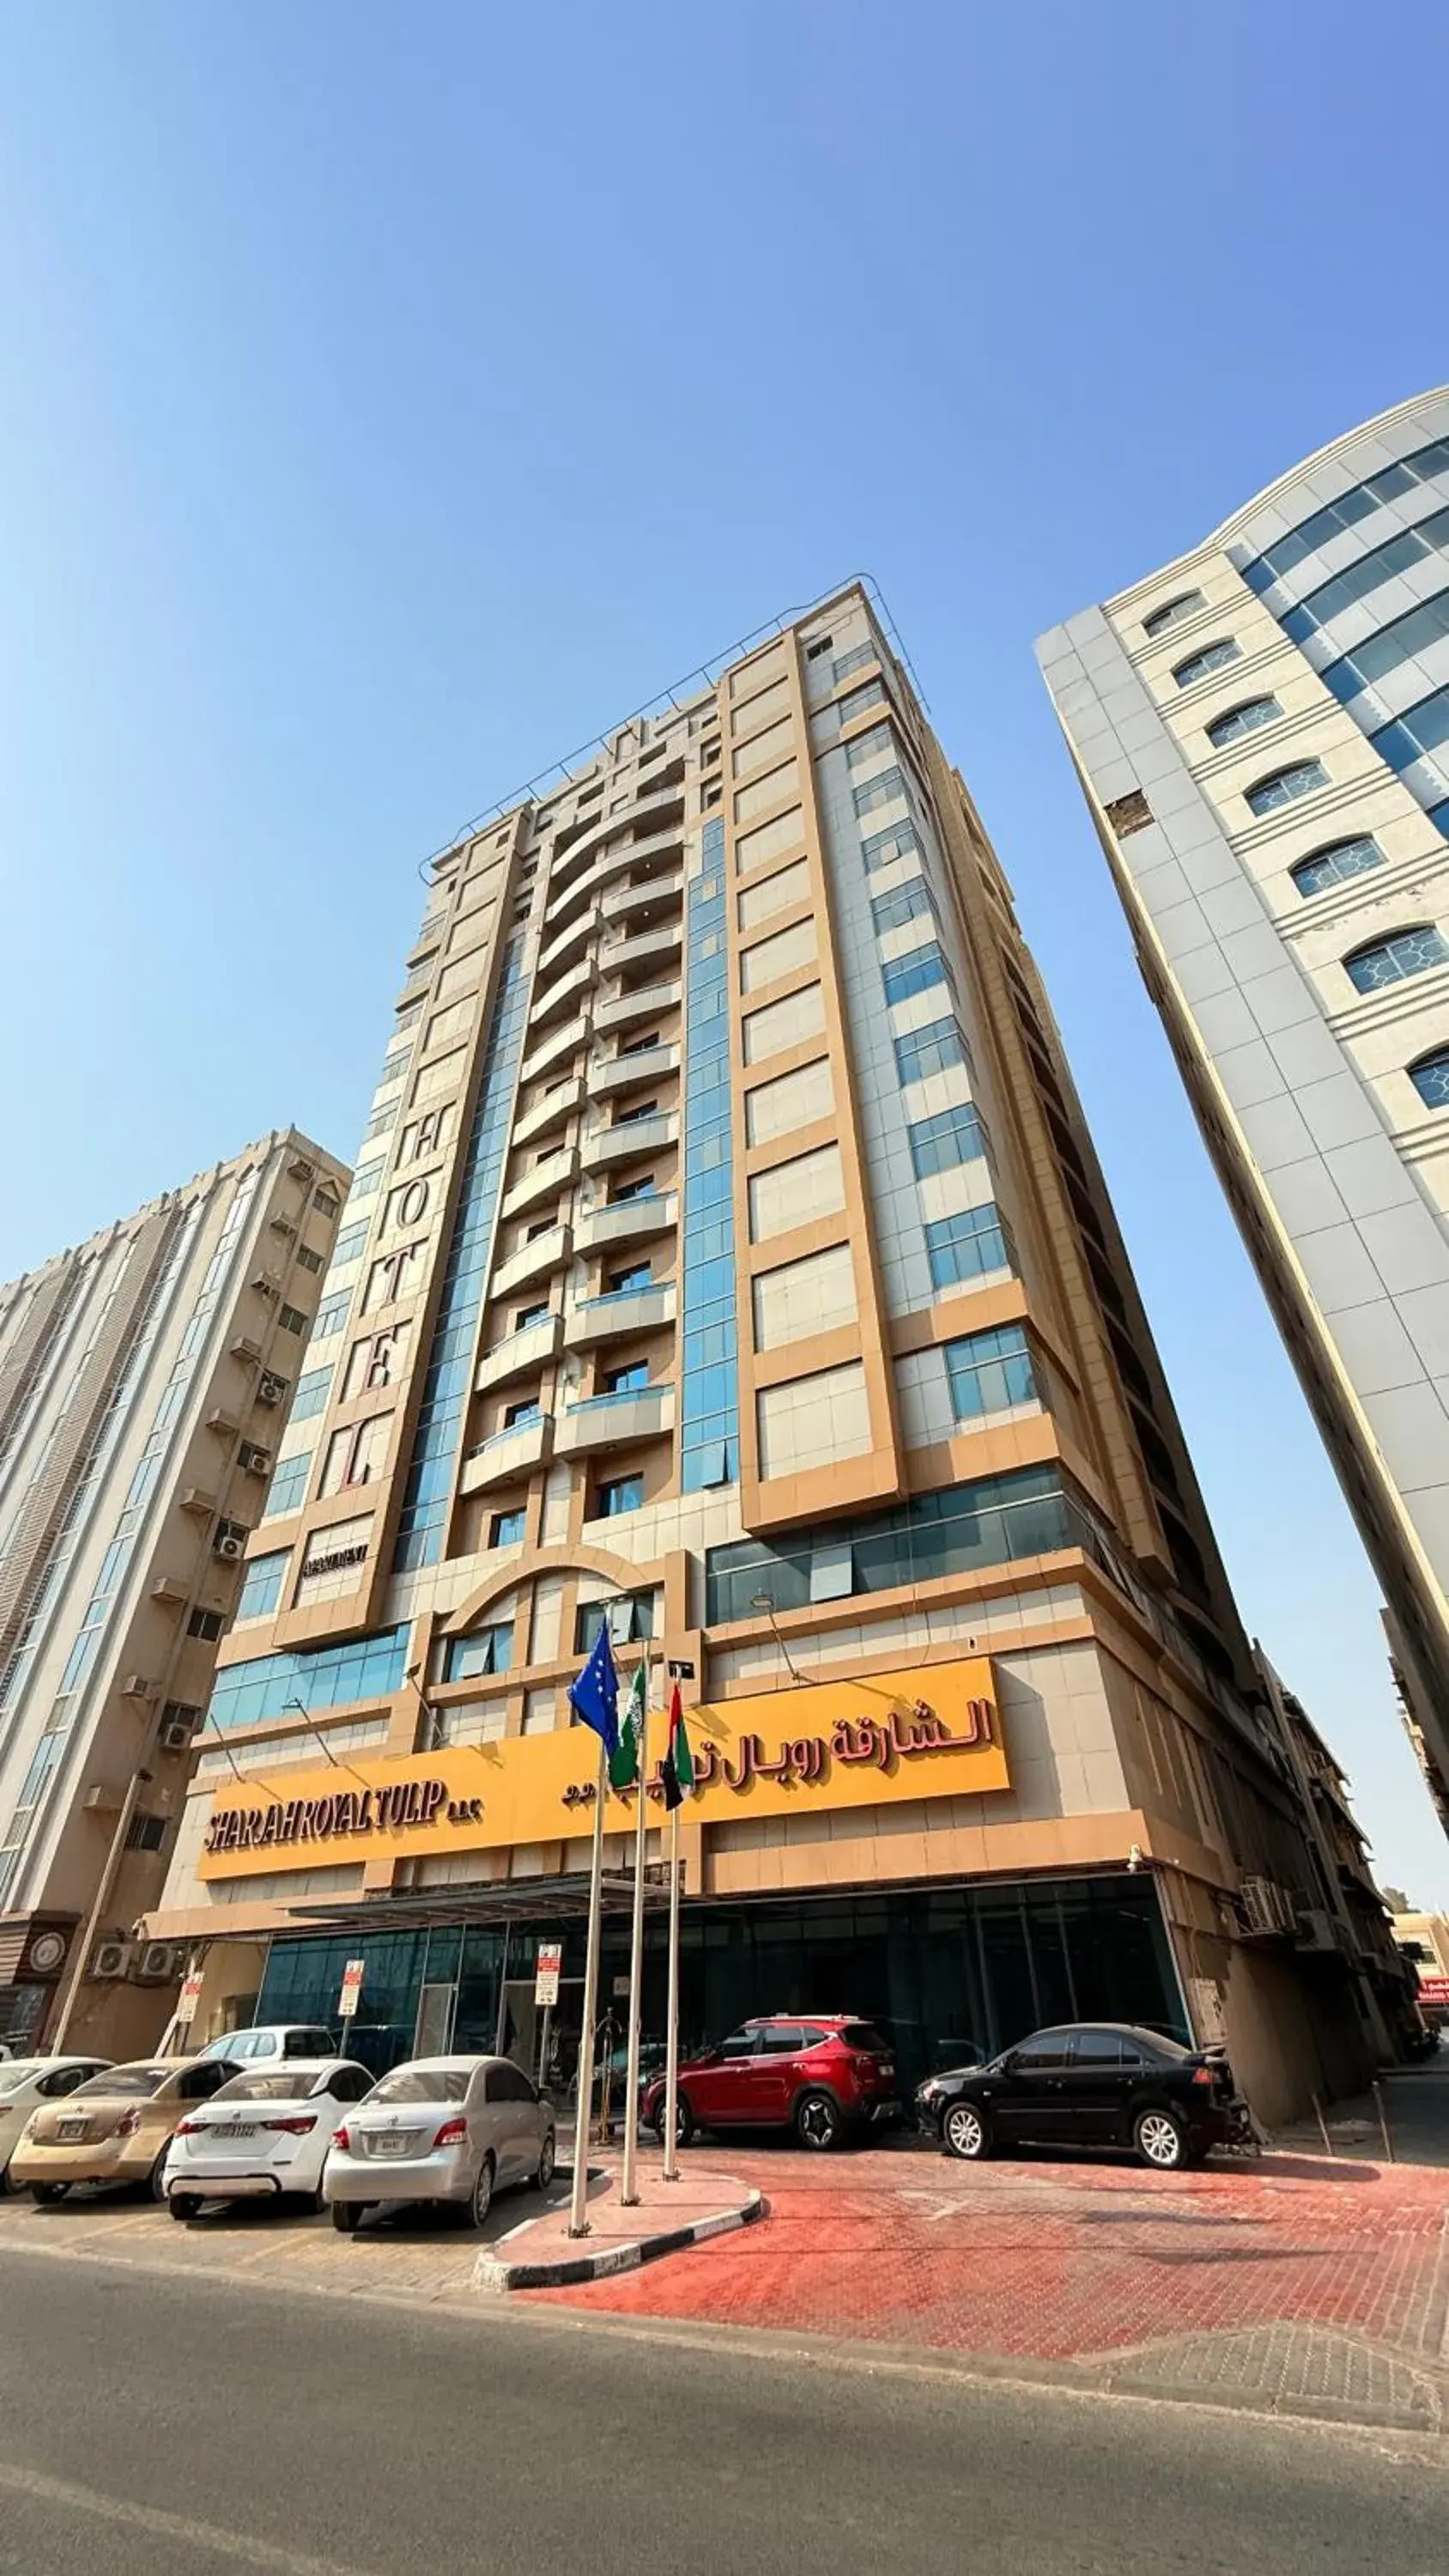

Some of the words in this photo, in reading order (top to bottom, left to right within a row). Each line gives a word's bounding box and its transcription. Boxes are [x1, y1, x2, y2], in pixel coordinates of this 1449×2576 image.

[336, 1106, 446, 1496] HOTEL
[719, 1733, 823, 1788] رويال
[829, 1698, 992, 1770] الشارقة
[204, 1801, 302, 1851] SHARJAH
[299, 1789, 373, 1838] ROYAL
[373, 1778, 450, 1826] TULIP
